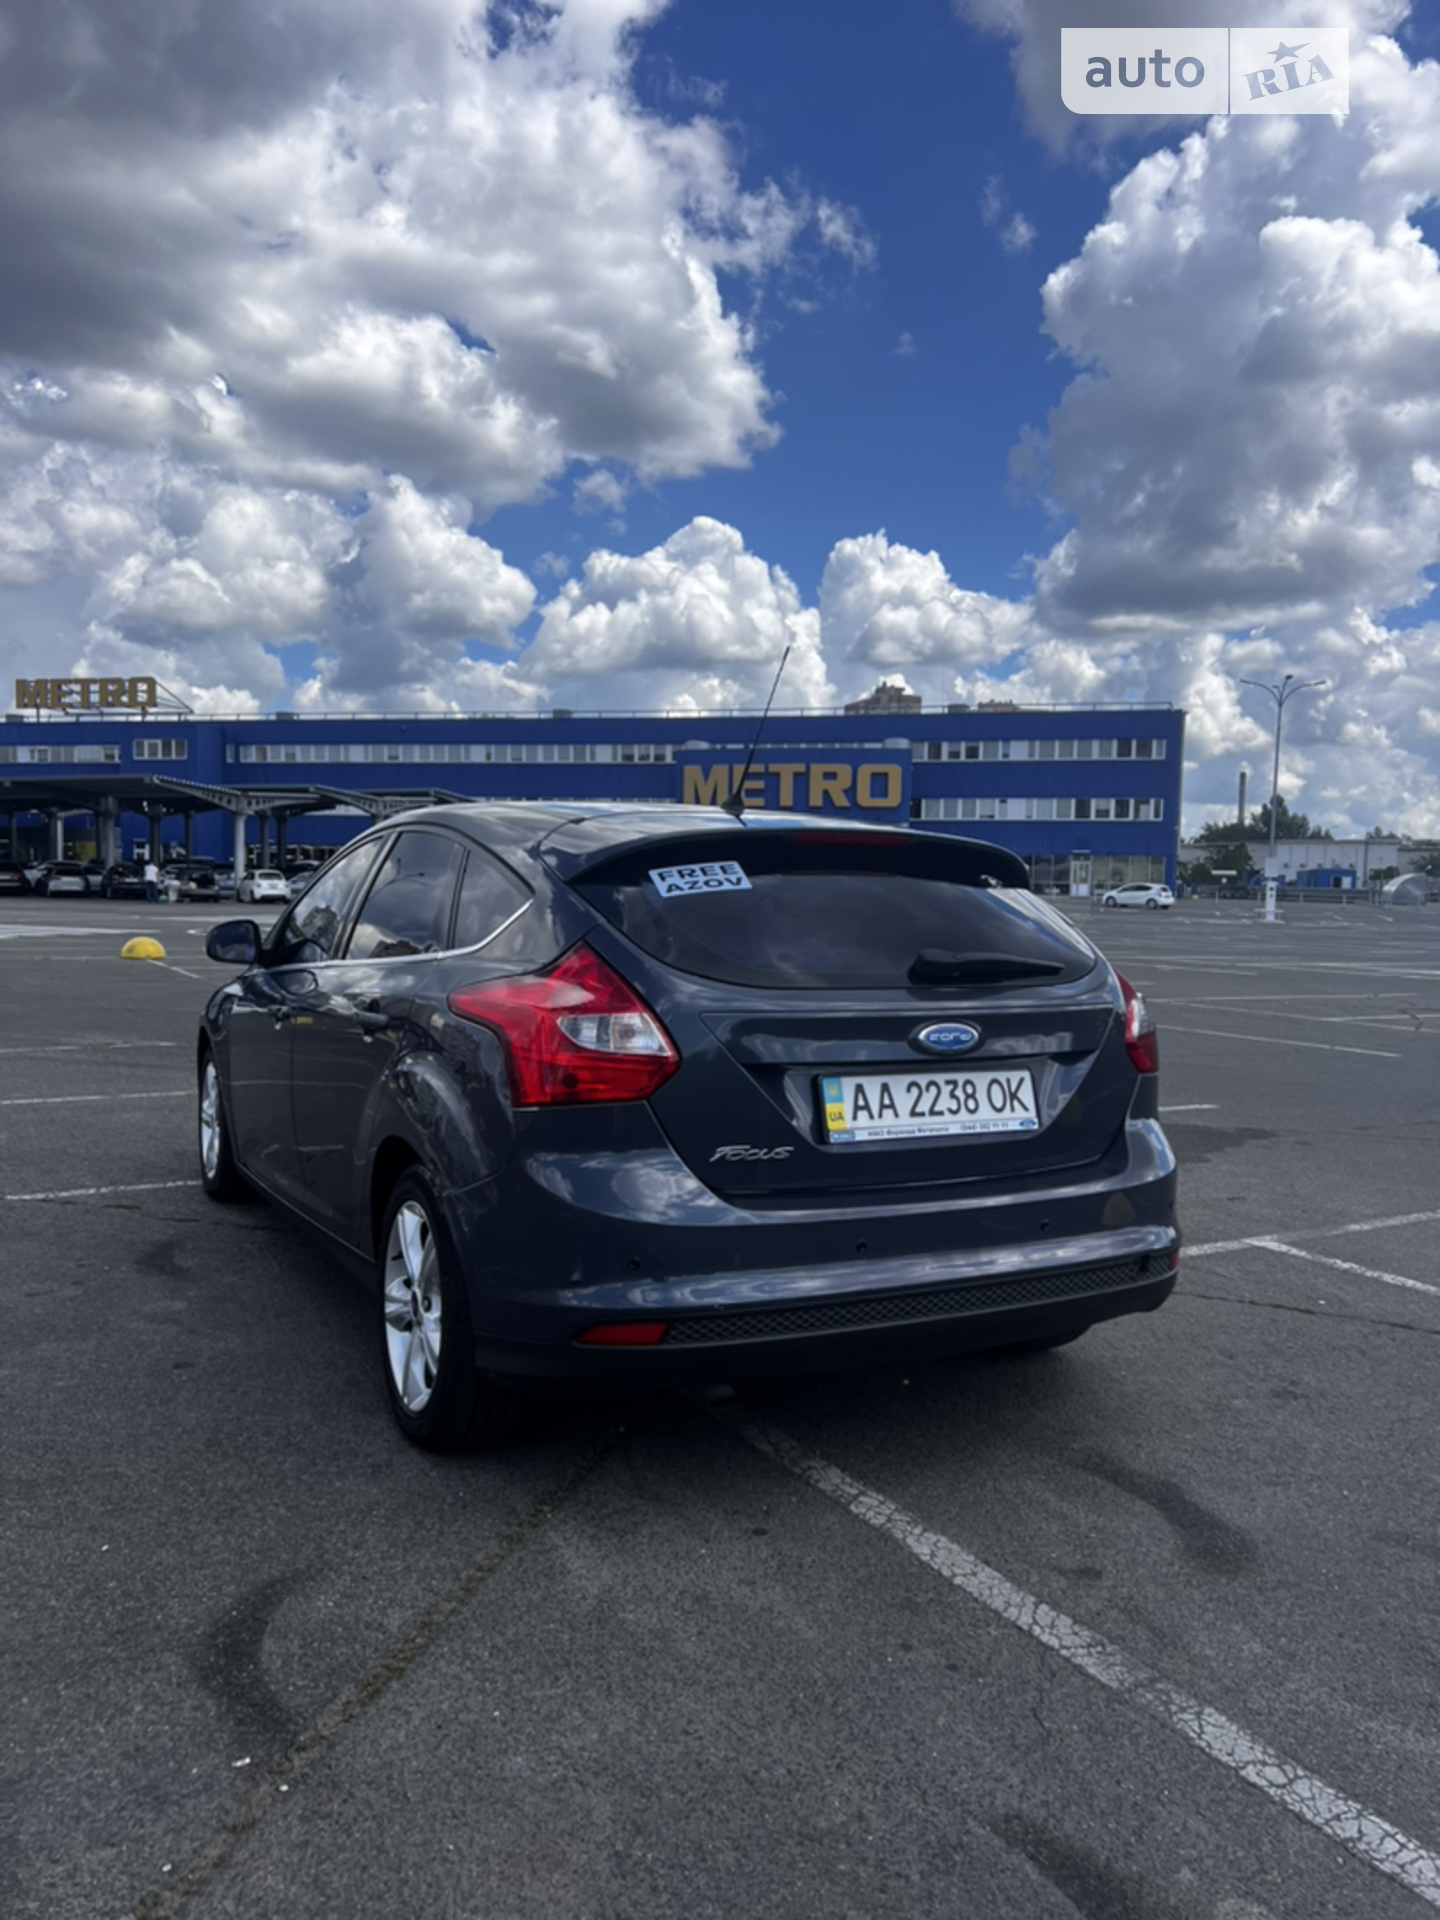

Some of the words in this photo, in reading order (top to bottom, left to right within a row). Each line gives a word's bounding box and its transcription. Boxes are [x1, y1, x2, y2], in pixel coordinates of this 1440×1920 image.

[15, 677, 157, 709] METRO
[683, 764, 902, 808] METRO
[657, 863, 739, 883] FREE
[665, 876, 743, 894] AZOV
[852, 1082, 899, 1122] AA
[906, 1079, 980, 1118] 2238
[986, 1076, 1030, 1114] OK
[829, 1111, 845, 1122] UA
